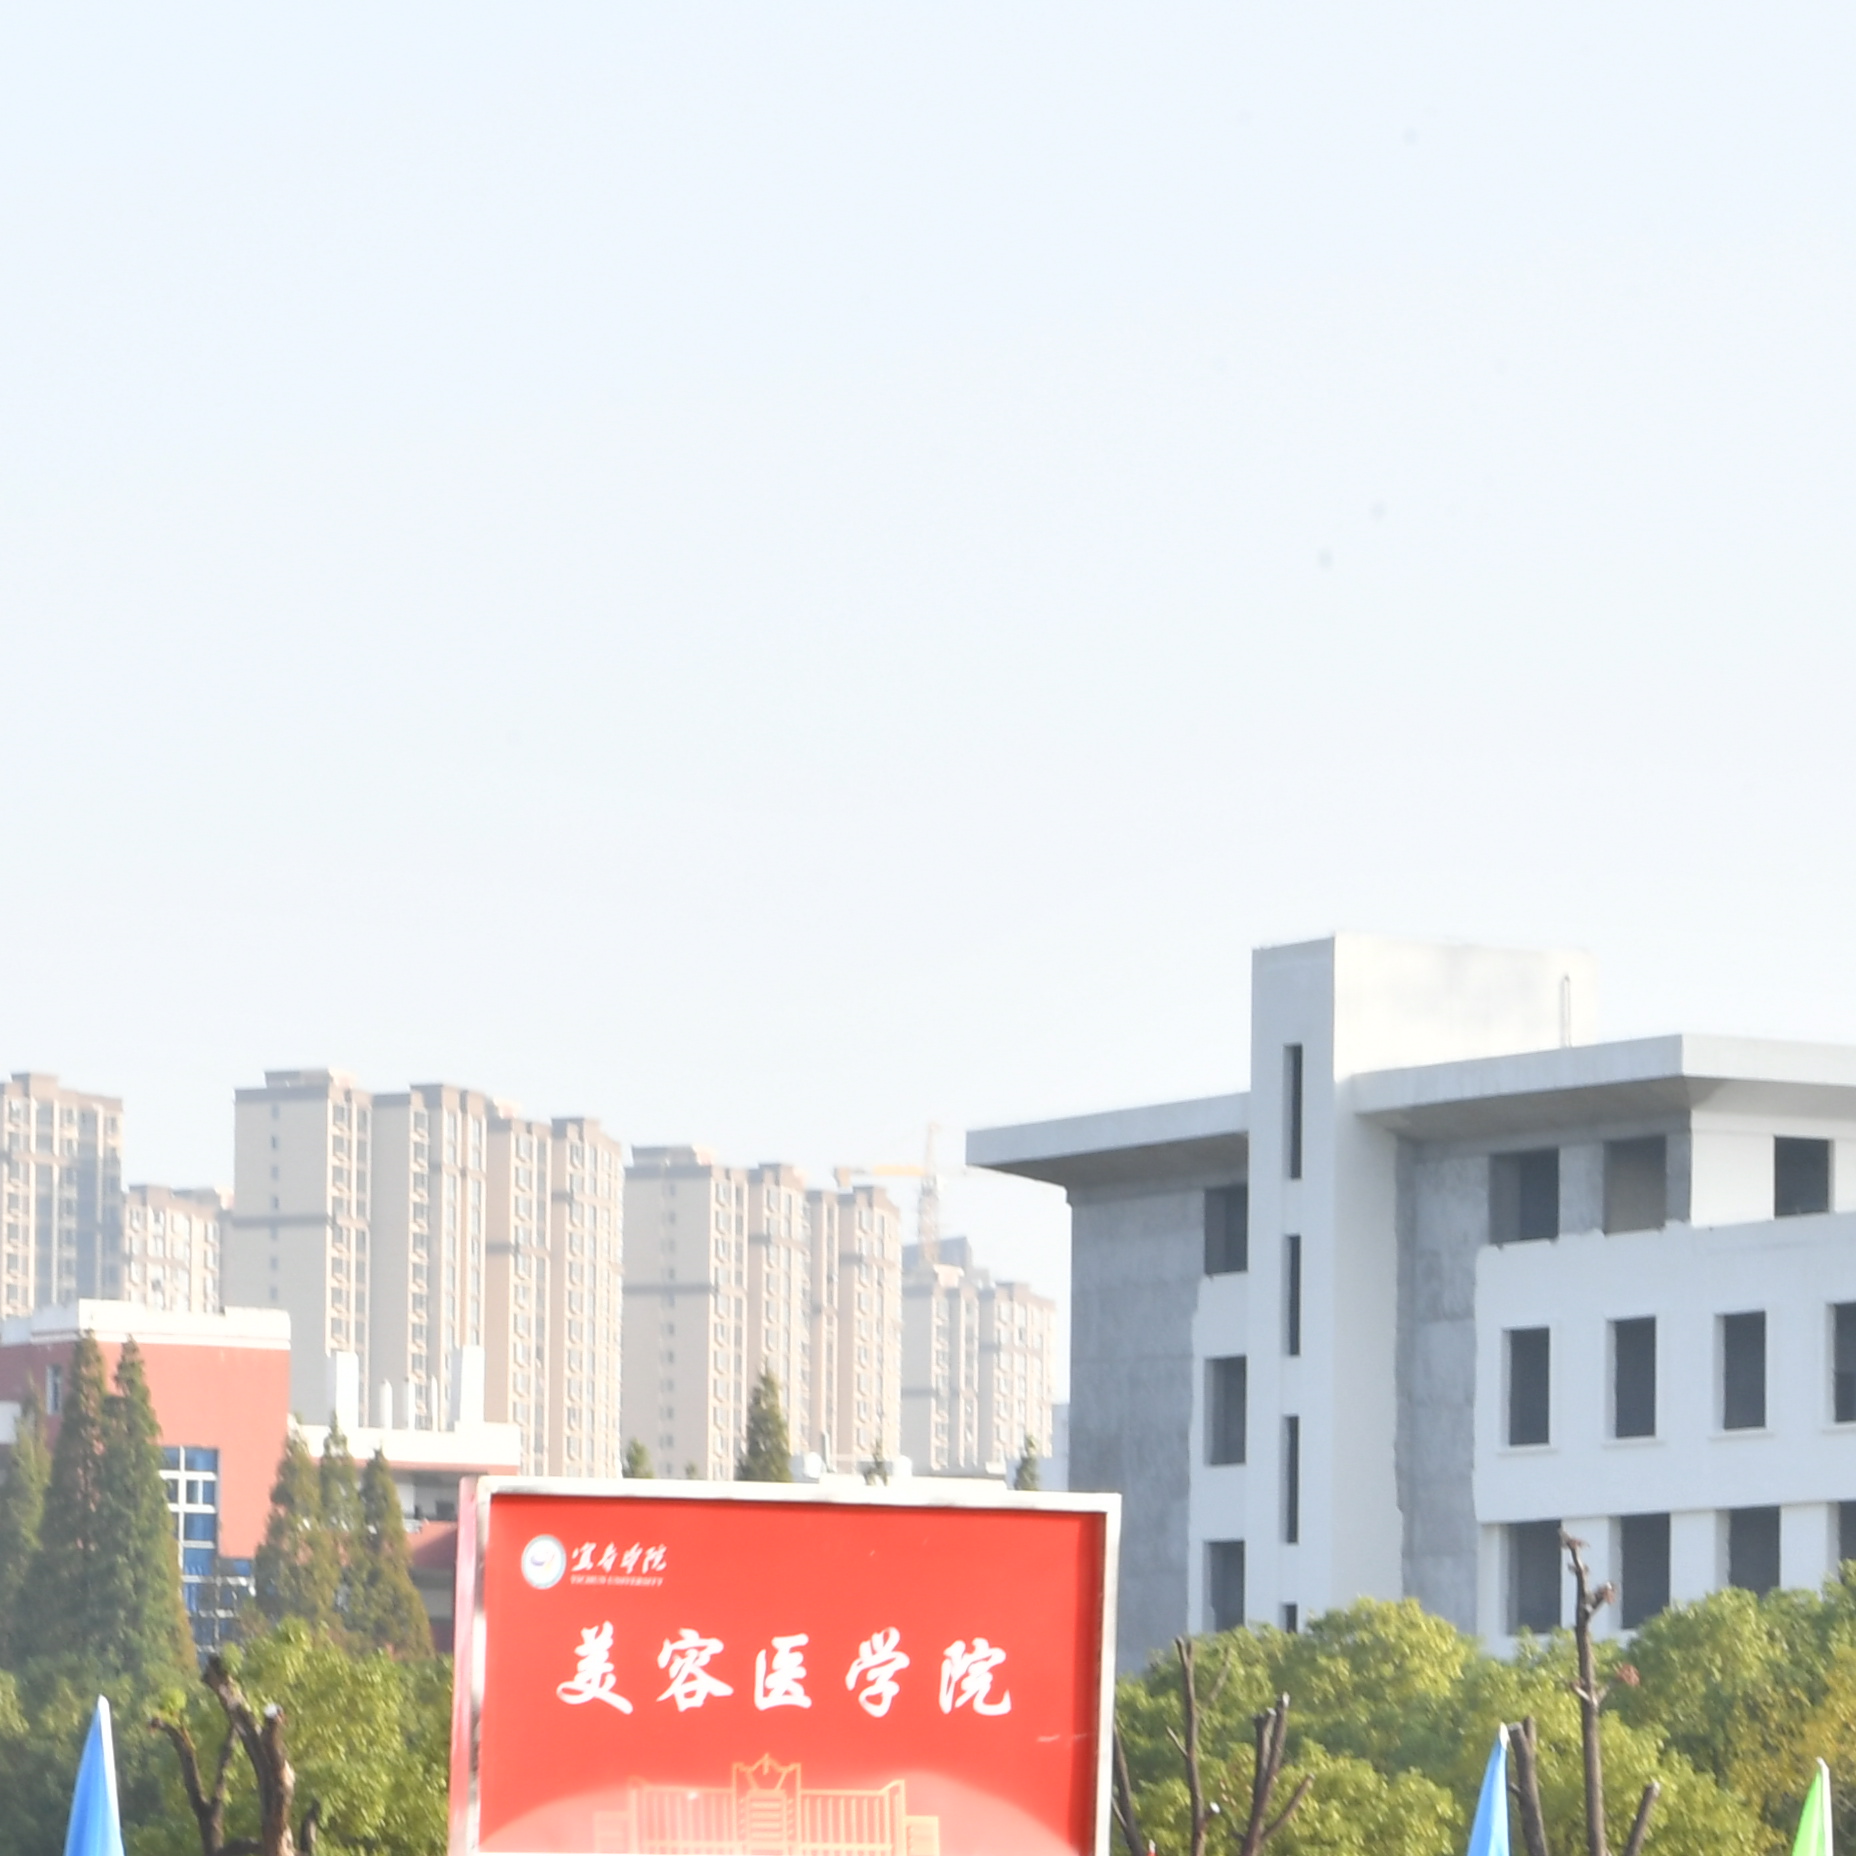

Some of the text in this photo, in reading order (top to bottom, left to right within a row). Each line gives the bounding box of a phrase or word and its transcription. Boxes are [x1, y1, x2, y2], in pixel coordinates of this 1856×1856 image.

[555, 1619, 1012, 1718] 美容医学院
